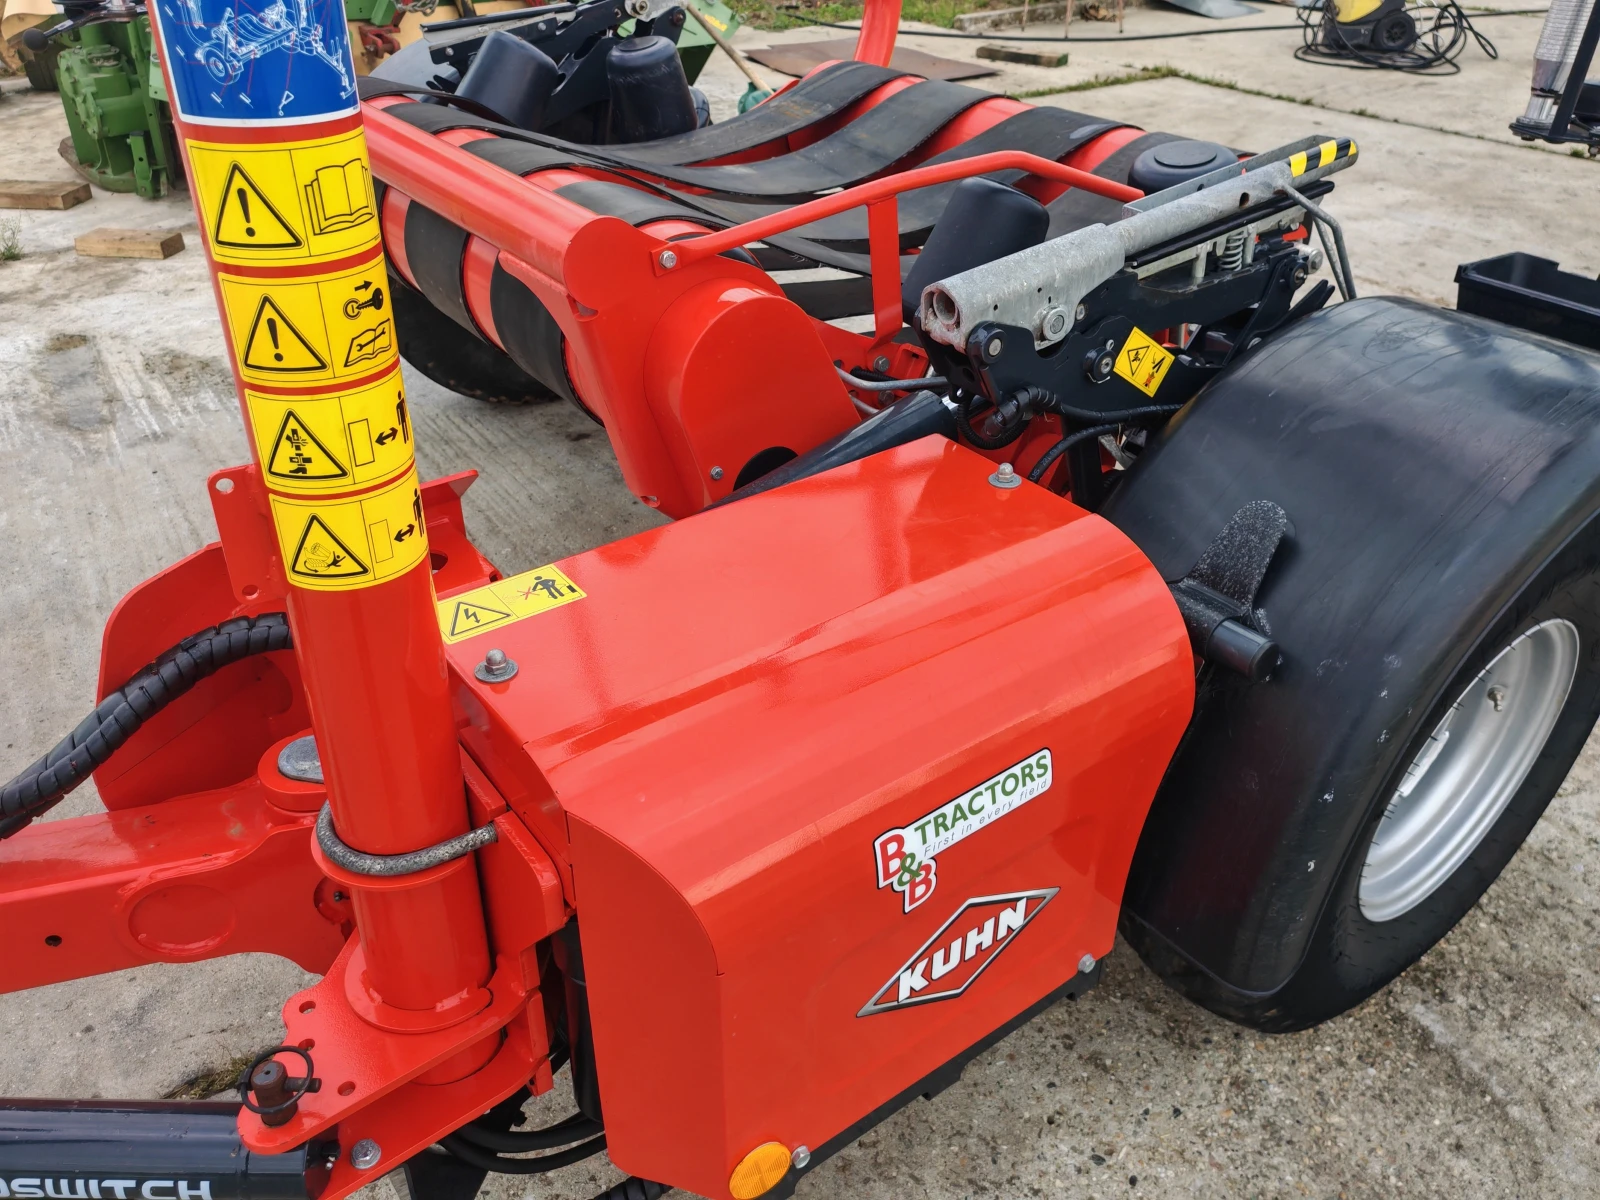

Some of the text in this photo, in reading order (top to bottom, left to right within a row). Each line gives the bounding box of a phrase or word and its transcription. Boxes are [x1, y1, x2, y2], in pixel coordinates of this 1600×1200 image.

[914, 754, 1049, 846] TRACTORS
[923, 778, 1048, 858] First in every field
[898, 896, 1028, 1003] KUHN
[0, 1177, 214, 1200] SWITCH
